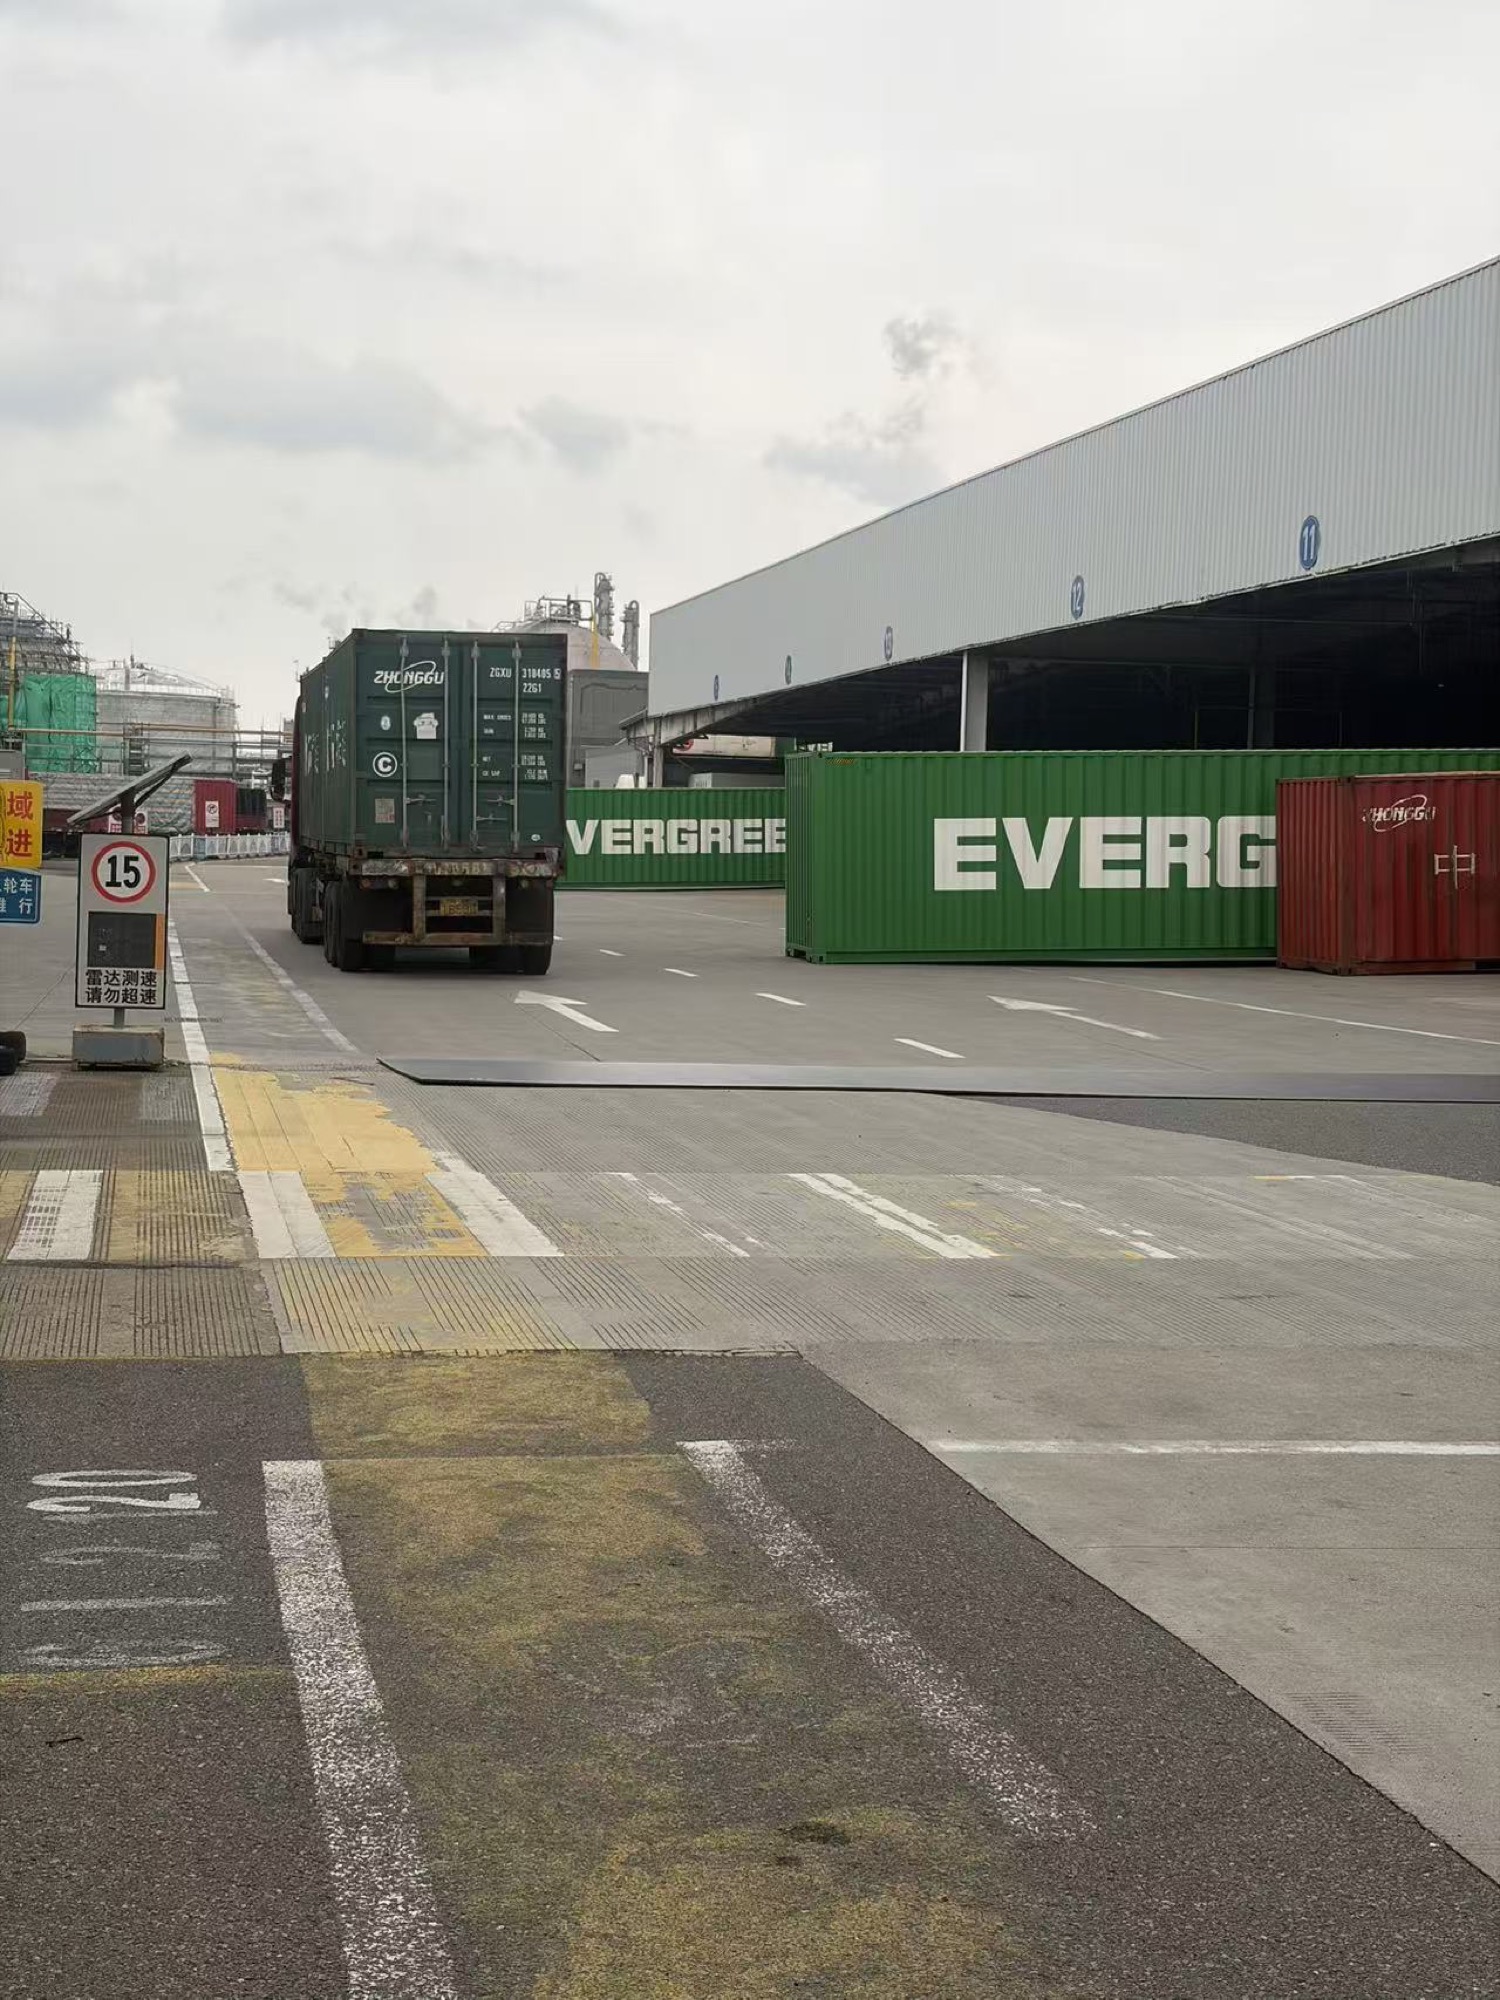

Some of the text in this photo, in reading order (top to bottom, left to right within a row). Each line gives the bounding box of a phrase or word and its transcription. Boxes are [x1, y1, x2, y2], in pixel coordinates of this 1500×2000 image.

[1302, 524, 1316, 561] 11
[1073, 582, 1083, 612] 12
[374, 670, 445, 685] ZHONGGU
[490, 667, 512, 678] ZGXU
[7, 790, 34, 821] 域
[6, 828, 33, 858] 进
[566, 818, 786, 855] VERGREE
[934, 815, 1276, 890] EVERG
[0, 876, 33, 895] 轮车
[104, 854, 142, 889] 15
[85, 969, 157, 987] 雷达测速
[85, 986, 157, 1005] 请勿超速
